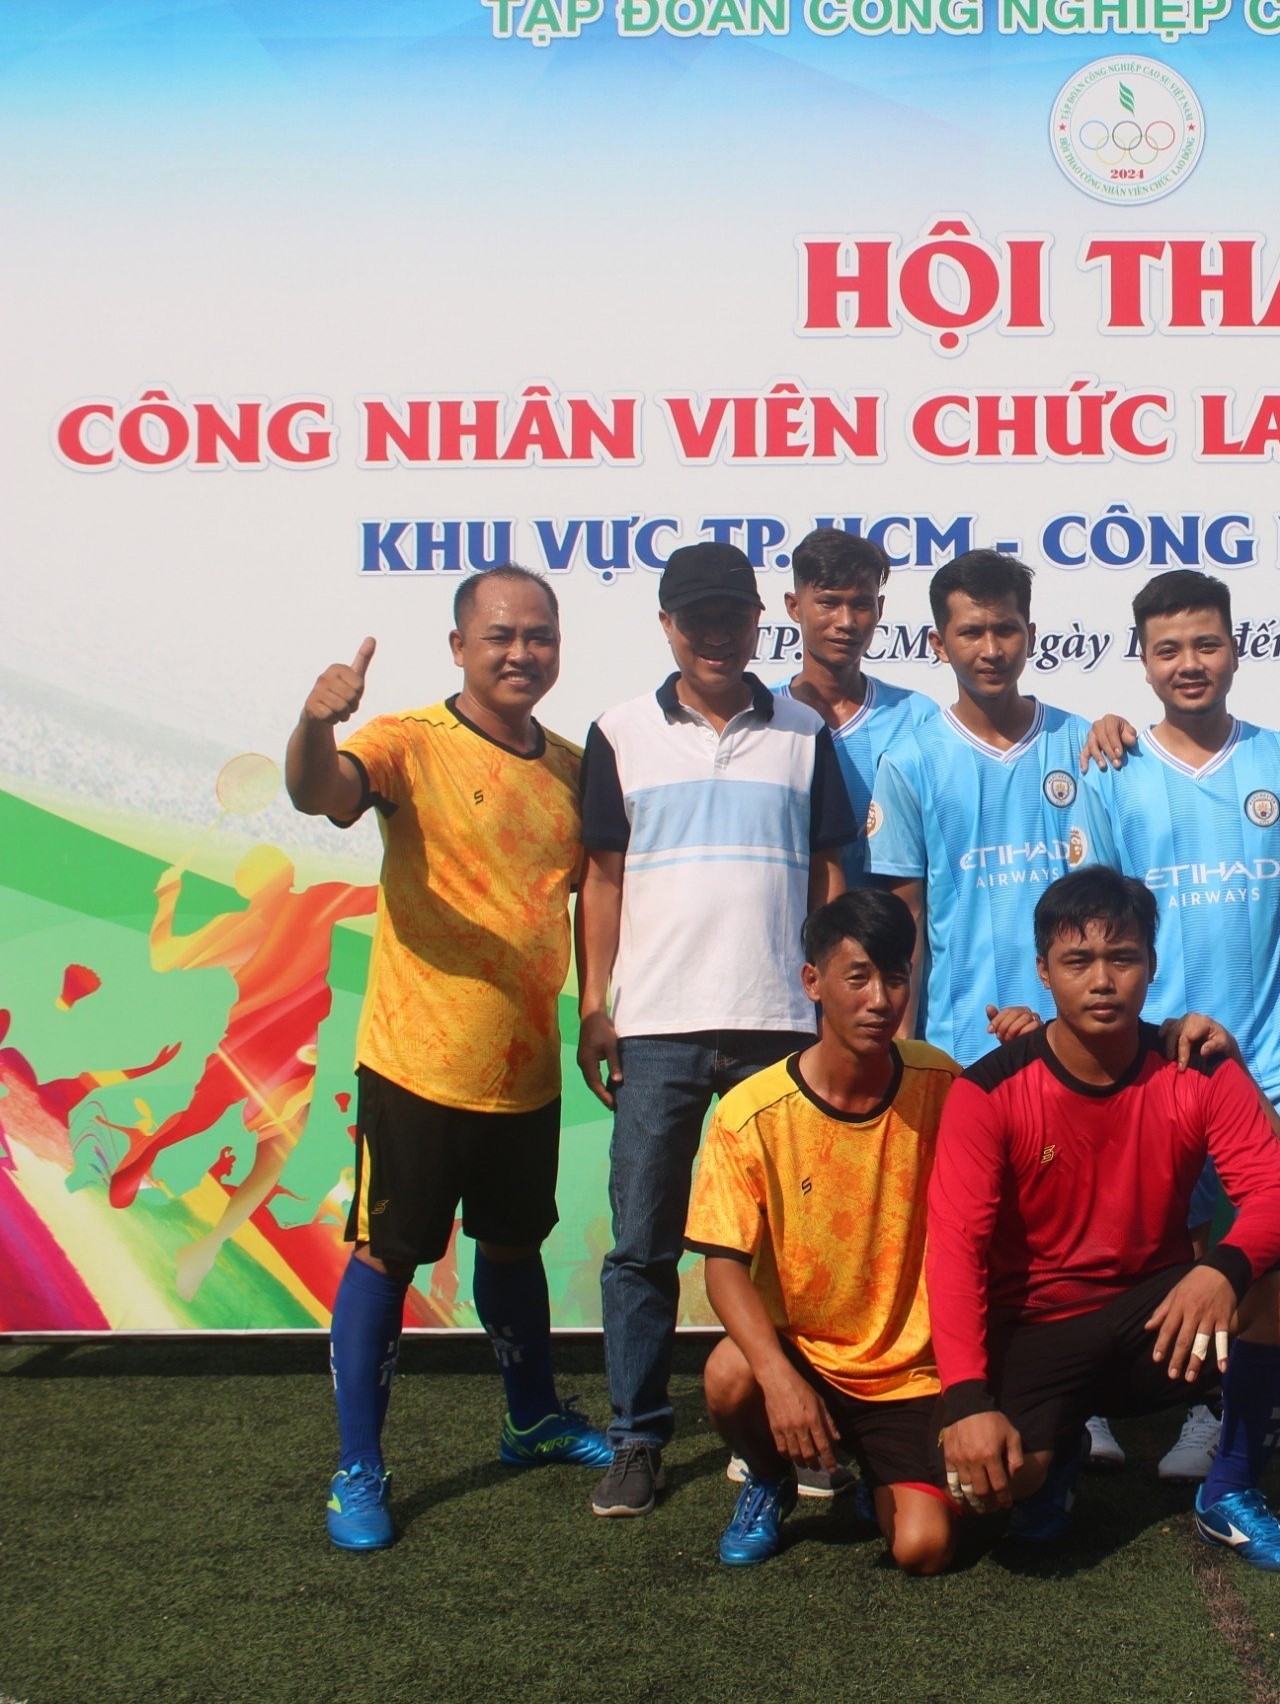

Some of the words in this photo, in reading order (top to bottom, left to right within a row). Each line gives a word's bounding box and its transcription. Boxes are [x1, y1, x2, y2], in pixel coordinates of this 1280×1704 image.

[1143, 66, 1160, 78] CAO
[1110, 169, 1144, 179] 2024
[802, 220, 1046, 350] HỘI
[57, 389, 332, 466] CÔNG
[363, 385, 637, 463] NHÂN
[664, 382, 880, 459] VIÊN
[911, 379, 1169, 458] CHỨC
[361, 520, 513, 571] KHU
[533, 516, 680, 581] VỰC
[1041, 504, 1255, 567] CÔNG
[1028, 622, 1111, 670] gày
[976, 867, 1061, 889] AIRWAYS
[1144, 858, 1280, 890] ETIHAD
[1168, 886, 1261, 909] AIRWAYS
